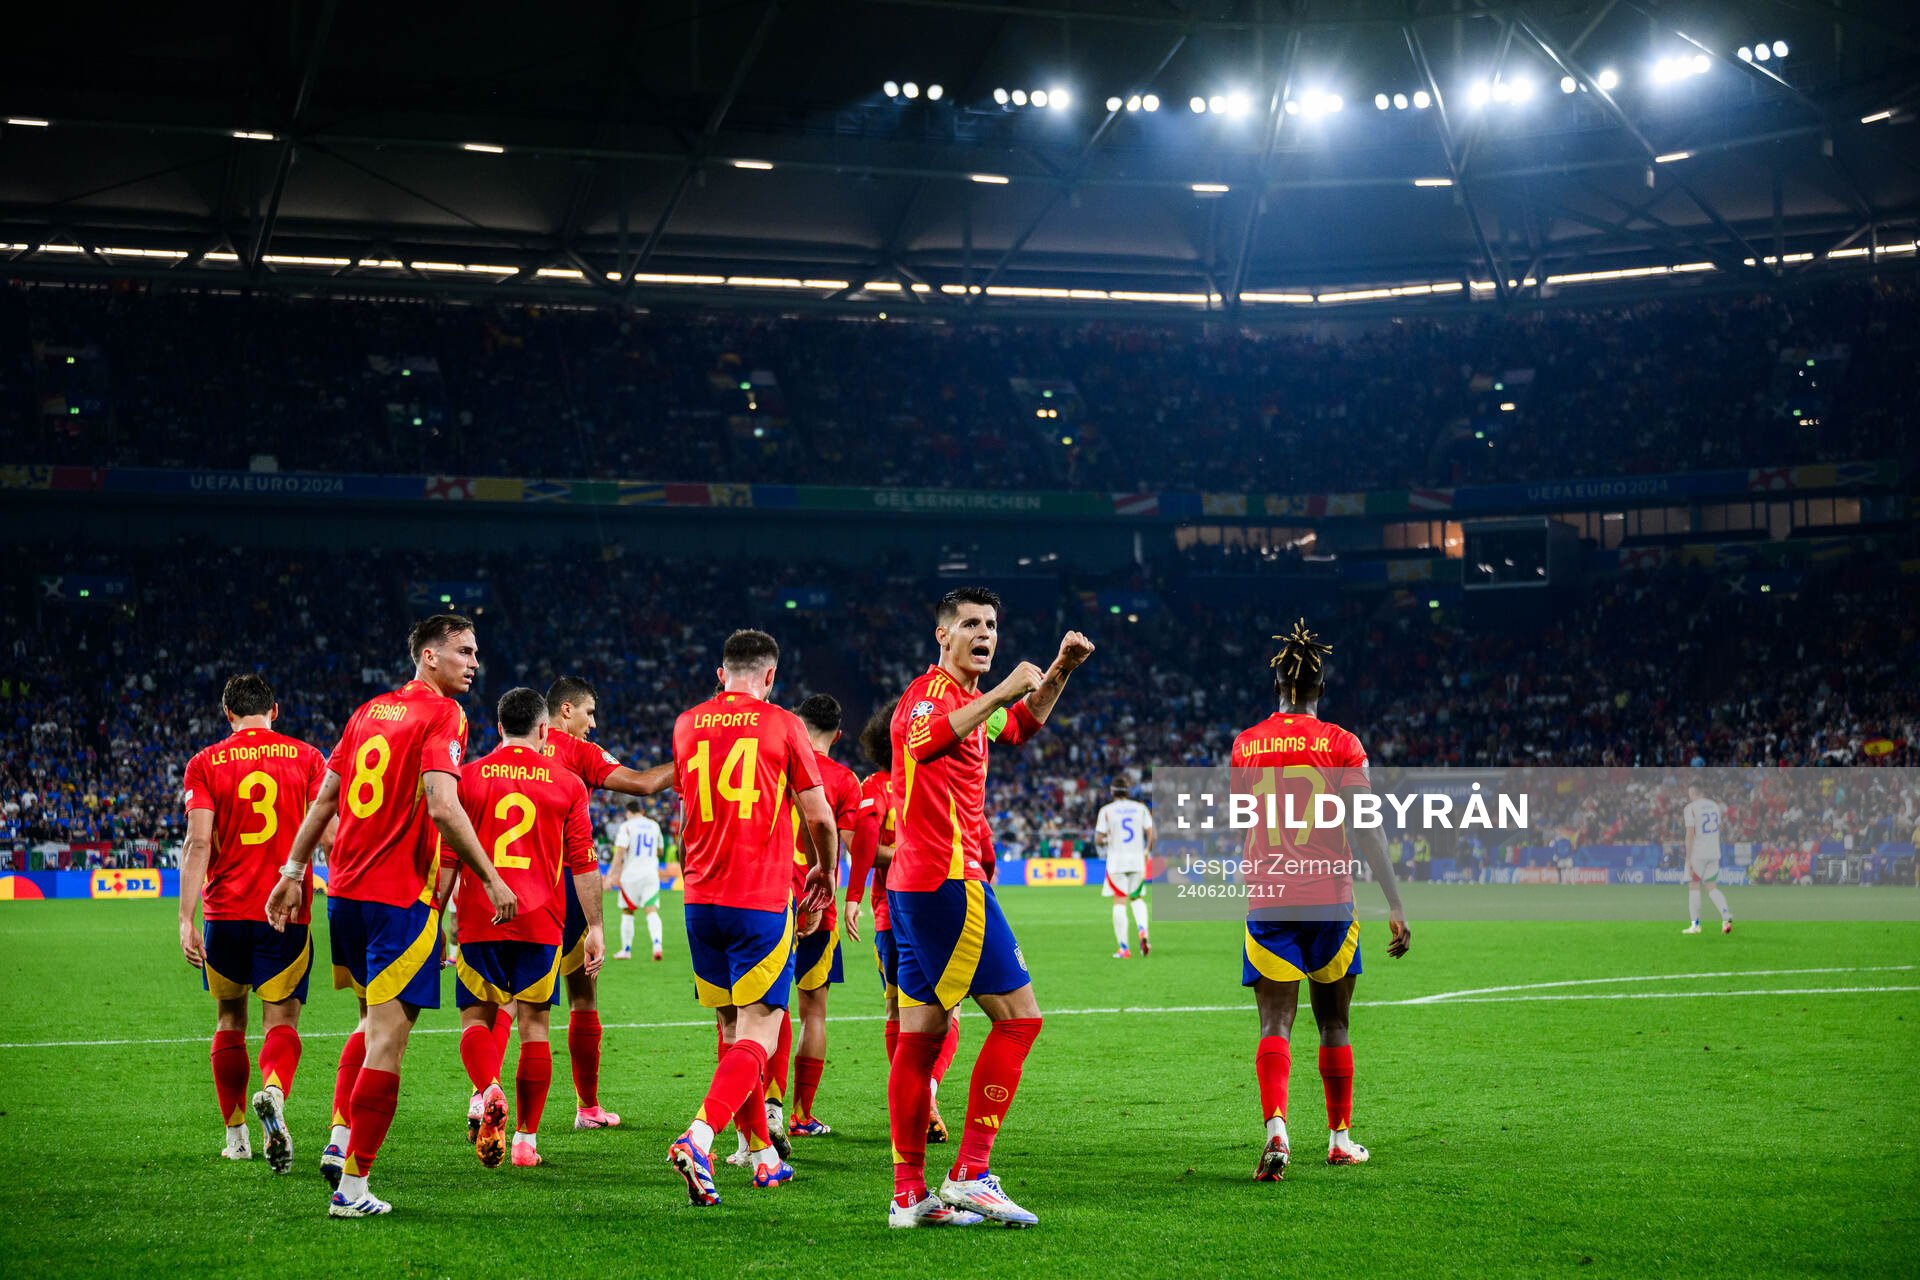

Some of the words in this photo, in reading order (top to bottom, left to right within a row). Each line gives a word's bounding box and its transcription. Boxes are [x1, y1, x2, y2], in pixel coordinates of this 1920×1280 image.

[873, 492, 1041, 510] GELSENKIRCHEN
[367, 702, 407, 721] FABIÁN
[694, 713, 760, 729] LAPORTE
[211, 751, 228, 766] LE
[229, 744, 298, 761] NORMAND
[1241, 736, 1306, 758] WILLIAMS
[1310, 738, 1332, 753] JR.
[347, 734, 391, 819] 8
[481, 764, 553, 783] CARVAJAL
[687, 737, 761, 823] 14
[238, 770, 278, 845] 3
[1252, 764, 1326, 847] 17
[493, 792, 537, 870] 2
[1121, 817, 1134, 843] 5
[1701, 812, 1719, 834] 23
[635, 833, 654, 857] 14
